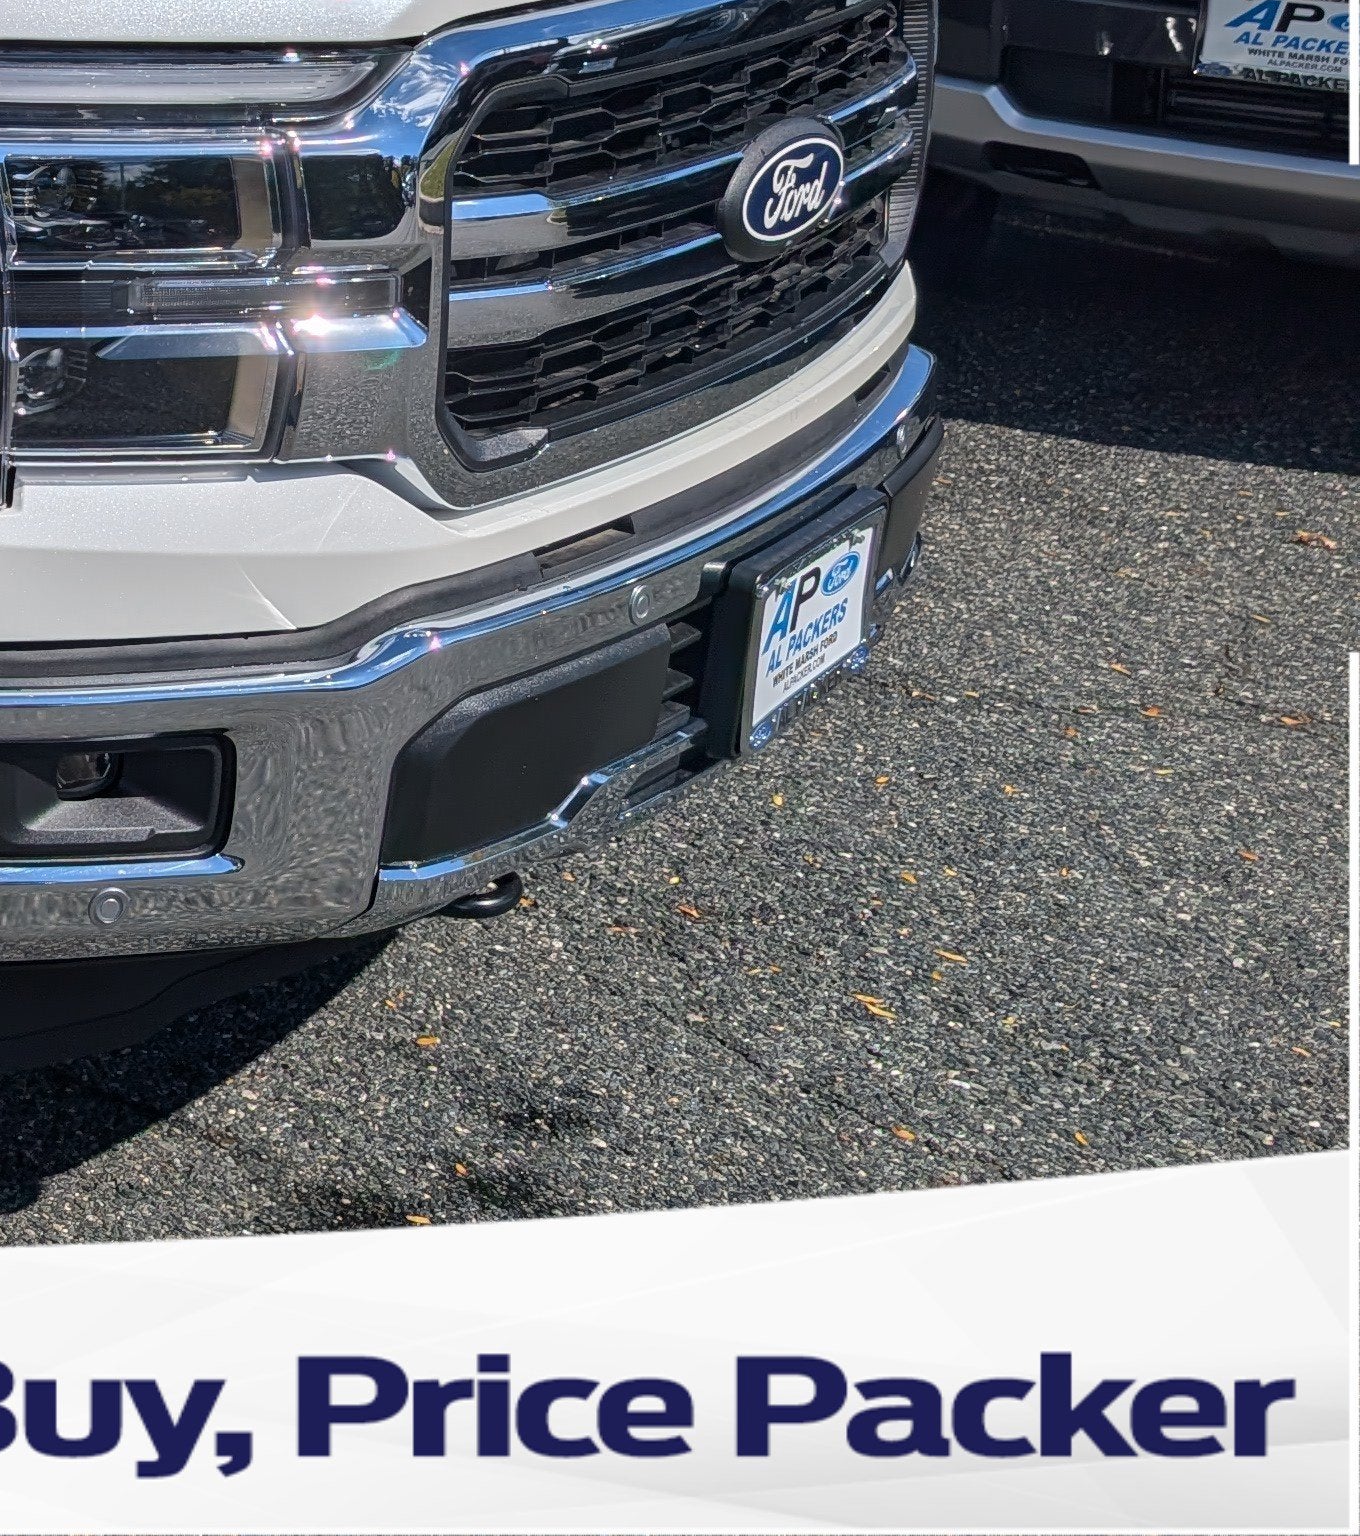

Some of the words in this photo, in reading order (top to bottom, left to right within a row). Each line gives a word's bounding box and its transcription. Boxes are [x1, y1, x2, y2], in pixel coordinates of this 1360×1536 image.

[1224, 0, 1325, 33] AP
[1233, 31, 1264, 46] AL
[1271, 34, 1349, 55] PACKE
[1248, 47, 1285, 59] WHITE
[1288, 52, 1330, 64] MARSH
[1271, 71, 1349, 90] PACKE
[763, 152, 829, 230] Ford
[761, 566, 822, 655] AP
[765, 642, 783, 678] AL
[786, 597, 848, 662] PACKERS
[820, 630, 839, 653] FORD
